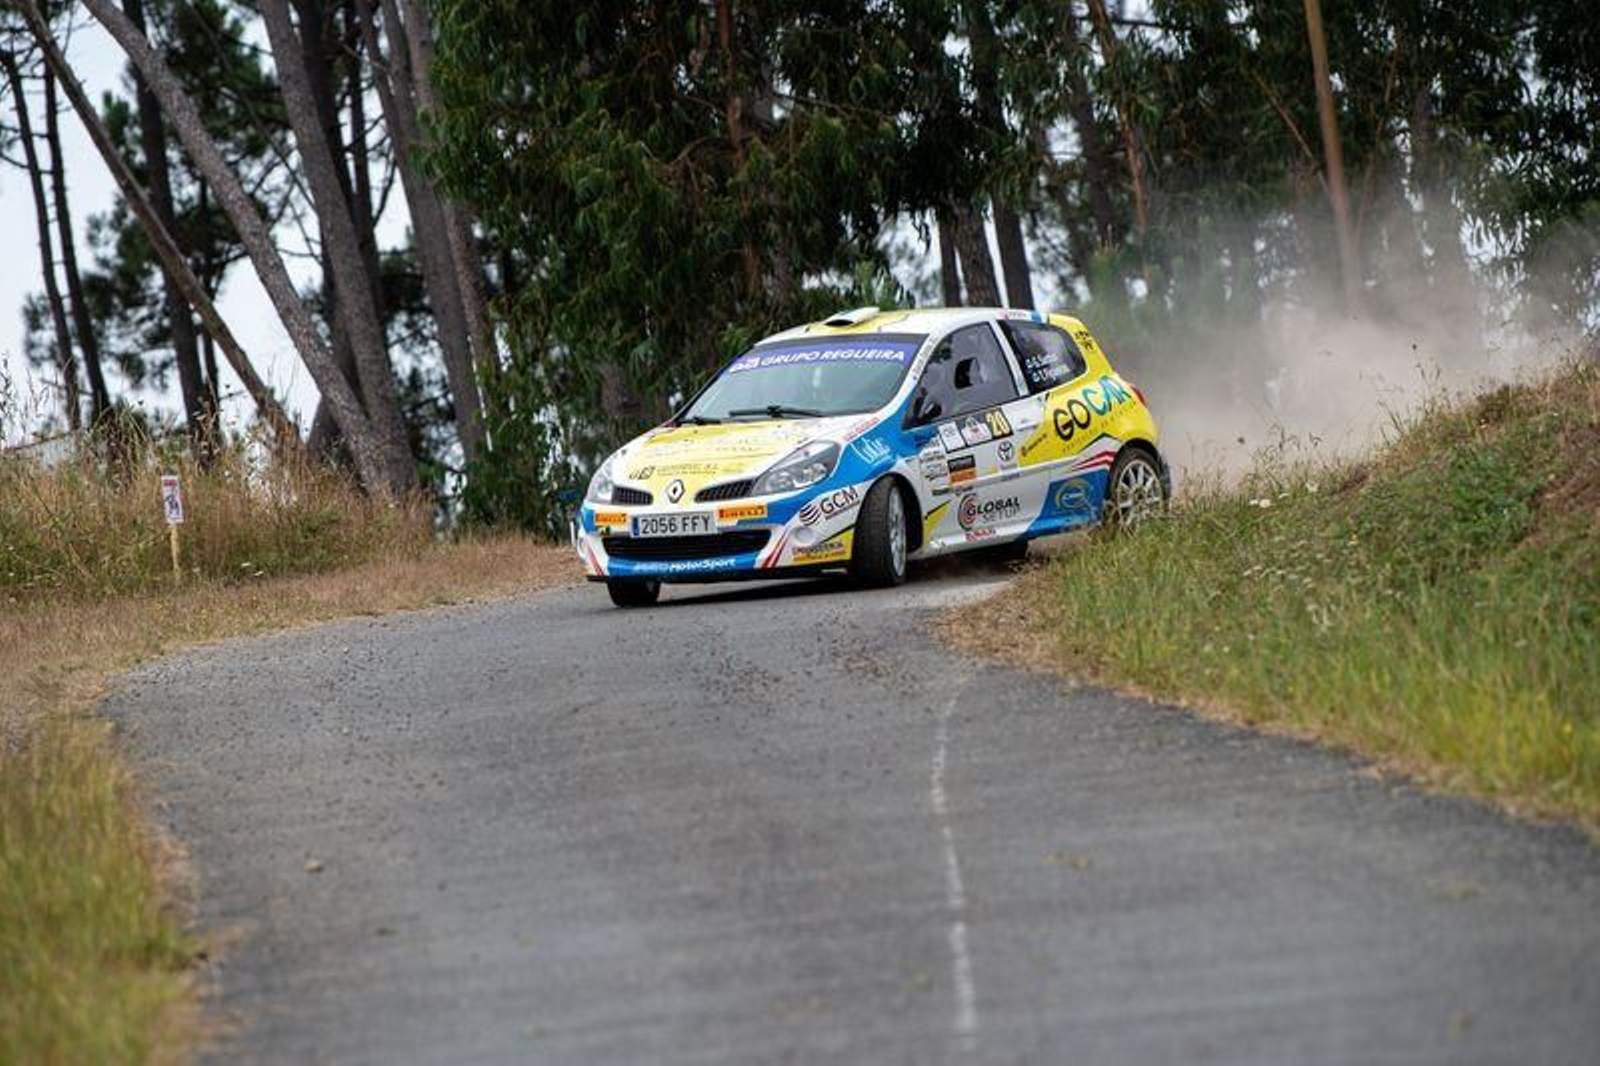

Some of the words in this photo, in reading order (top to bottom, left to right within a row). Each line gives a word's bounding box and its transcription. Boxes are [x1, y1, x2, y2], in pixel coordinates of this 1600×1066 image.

[761, 351, 820, 366] GRUPO
[820, 486, 858, 514] GCM
[967, 496, 1020, 516] GLOBAL
[640, 517, 679, 535] 2056
[682, 515, 711, 532] FFY
